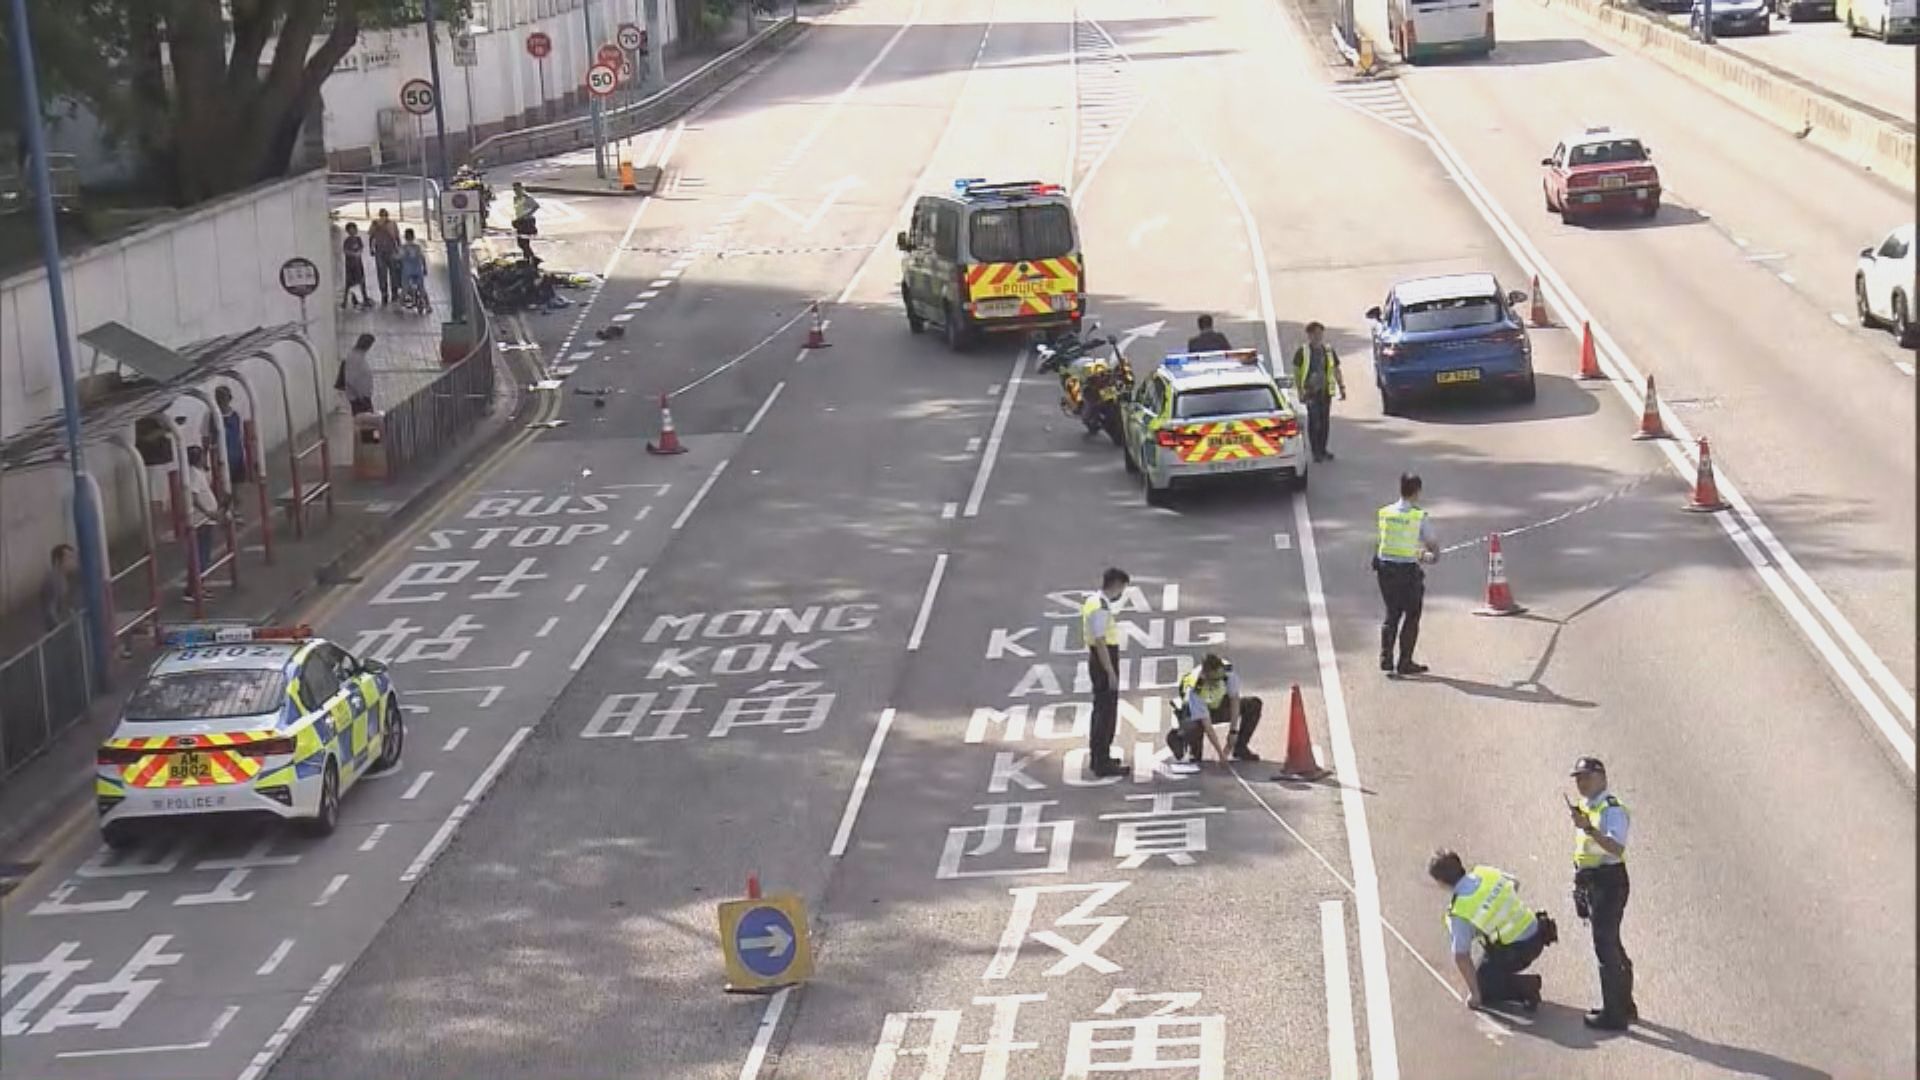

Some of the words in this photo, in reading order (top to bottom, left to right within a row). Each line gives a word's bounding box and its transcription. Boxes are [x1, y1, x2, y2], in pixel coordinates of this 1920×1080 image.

[622, 33, 638, 44] 70
[591, 72, 612, 87] 50
[406, 89, 432, 106] 50
[1003, 281, 1043, 295] POLICE
[464, 494, 620, 519] BUS
[413, 524, 609, 551] STOP
[368, 557, 548, 605] 巴士
[1043, 583, 1180, 618] SAI
[348, 614, 485, 664] 站
[640, 603, 880, 643] MONG
[177, 645, 273, 661] 8802
[645, 638, 833, 679] KOK
[579, 679, 837, 742] 旺角
[963, 696, 1184, 744] MON
[170, 764, 209, 779] 8802
[180, 754, 199, 765] AM
[167, 798, 213, 809] POLICE
[935, 791, 1227, 880] 西貢
[982, 881, 1132, 979] 及
[0, 934, 185, 1035] 站
[866, 988, 1227, 1080] 旺角
